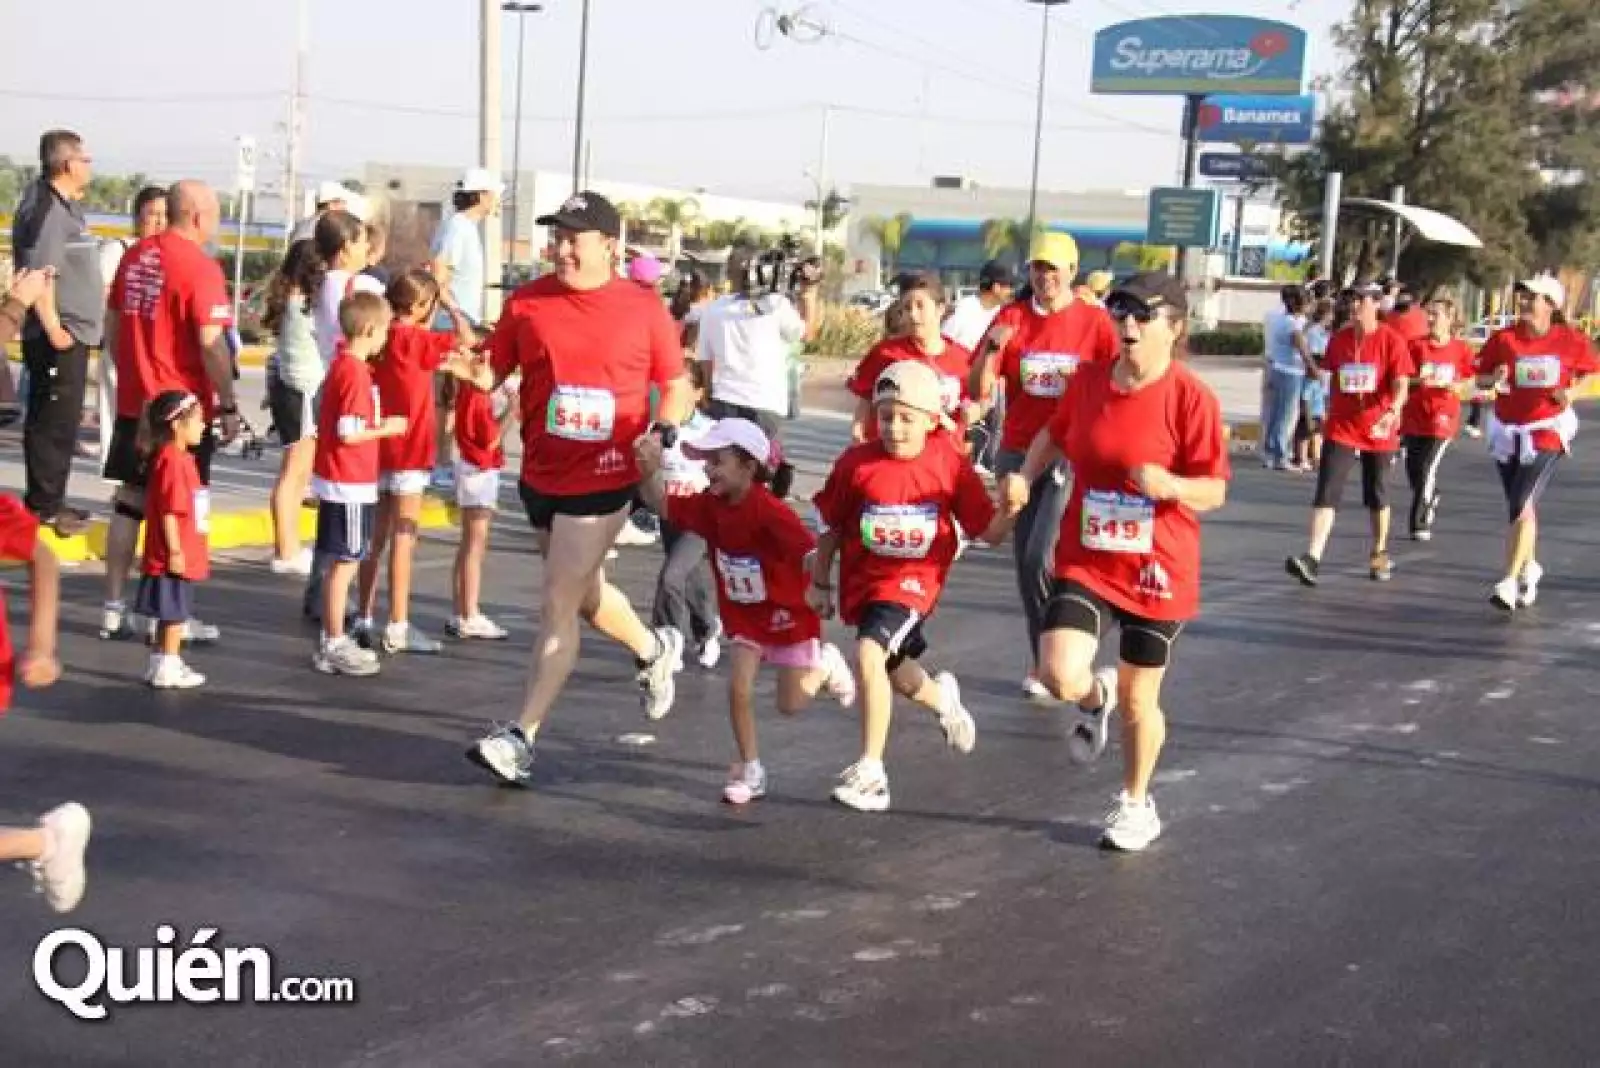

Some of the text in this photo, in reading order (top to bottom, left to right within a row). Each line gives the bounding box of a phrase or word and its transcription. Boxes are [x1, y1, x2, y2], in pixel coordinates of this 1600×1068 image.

[1110, 36, 1250, 74] Superama
[1223, 107, 1300, 124] Banamex
[555, 407, 601, 431] 544
[873, 527, 926, 549] 539
[1085, 515, 1138, 540] 549
